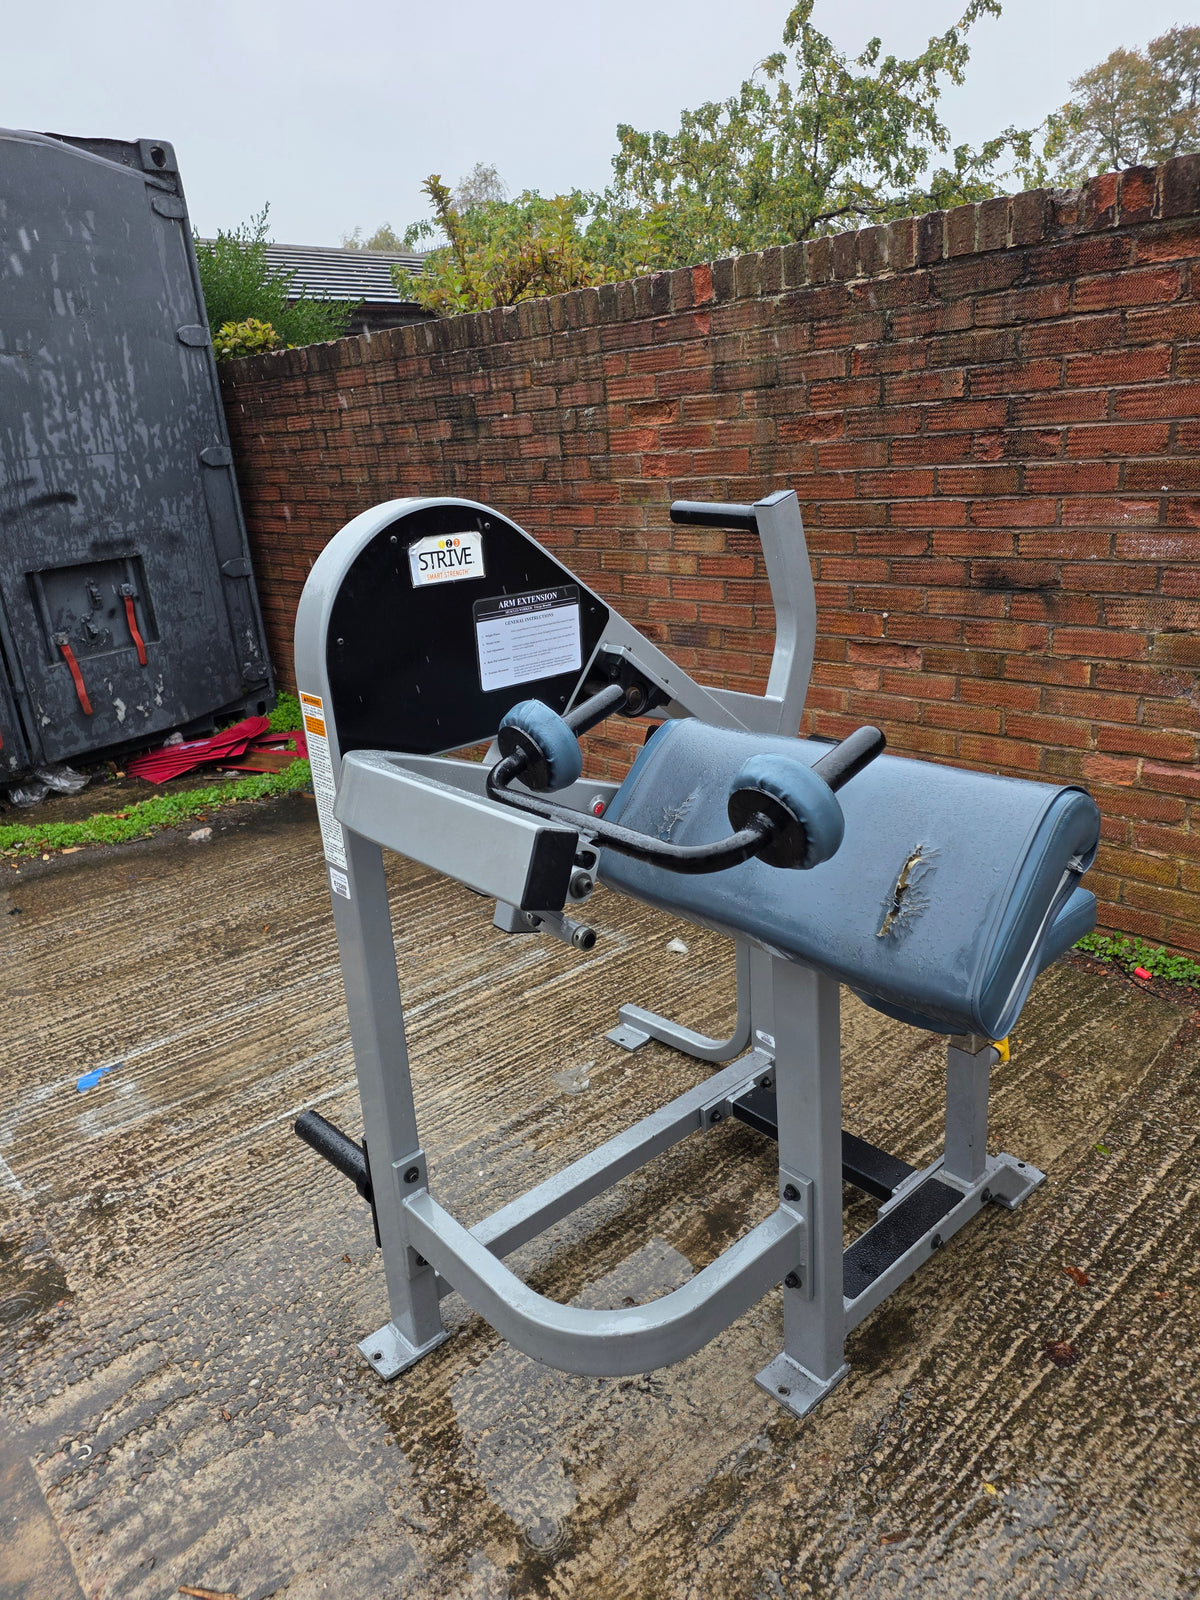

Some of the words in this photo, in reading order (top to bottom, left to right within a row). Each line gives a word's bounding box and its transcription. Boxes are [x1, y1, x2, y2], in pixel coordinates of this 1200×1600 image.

[419, 547, 472, 571] STRIVE
[426, 572, 443, 580] SMART
[444, 569, 469, 578] STRENGTH
[498, 598, 516, 609] ARM
[517, 592, 558, 606] EXTENSION
[504, 617, 524, 625] GENERAL
[524, 613, 554, 622] INSTRUCTIONS
